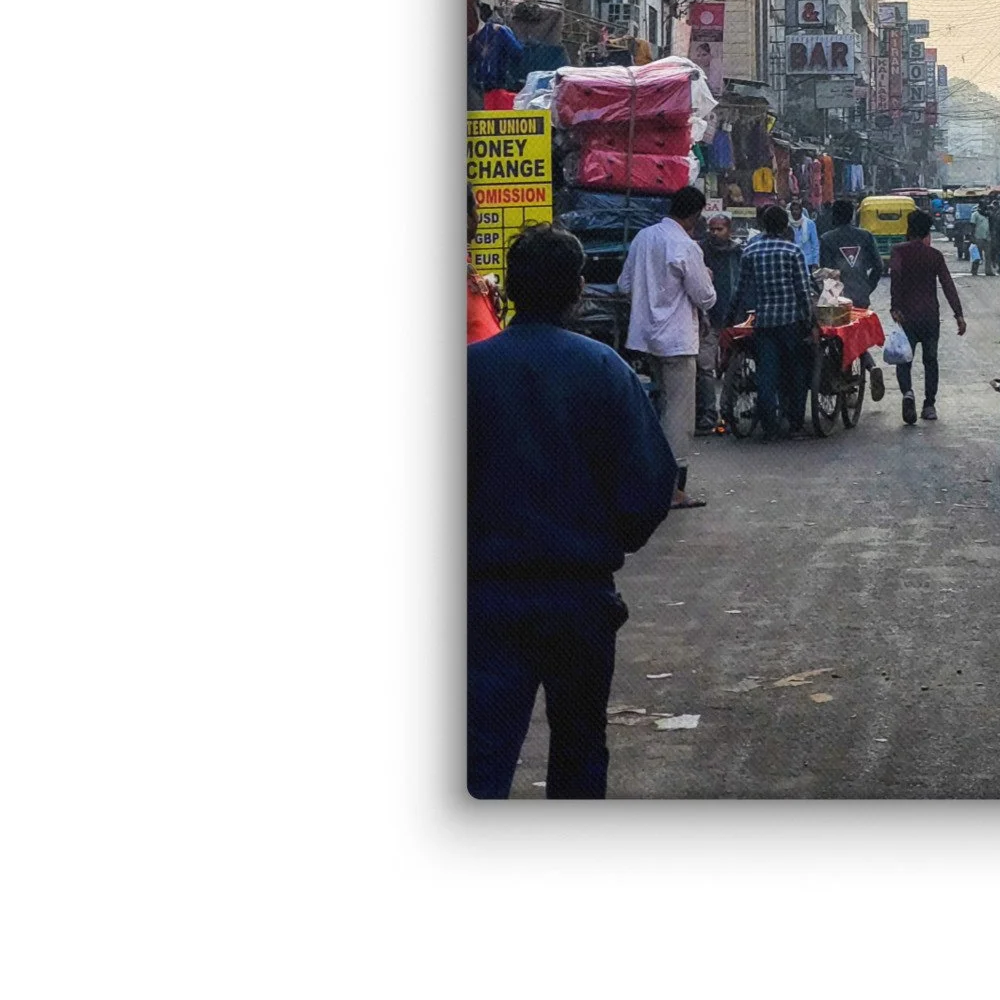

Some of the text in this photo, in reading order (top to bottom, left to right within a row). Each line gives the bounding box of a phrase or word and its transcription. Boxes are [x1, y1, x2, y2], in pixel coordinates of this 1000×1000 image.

[802, 2, 820, 23] &
[789, 41, 848, 68] BAR
[499, 118, 536, 134] UNION
[467, 159, 545, 179] CHANGE
[475, 188, 546, 204] OMISSION
[475, 233, 499, 244] GBP
[475, 254, 500, 265] EUR
